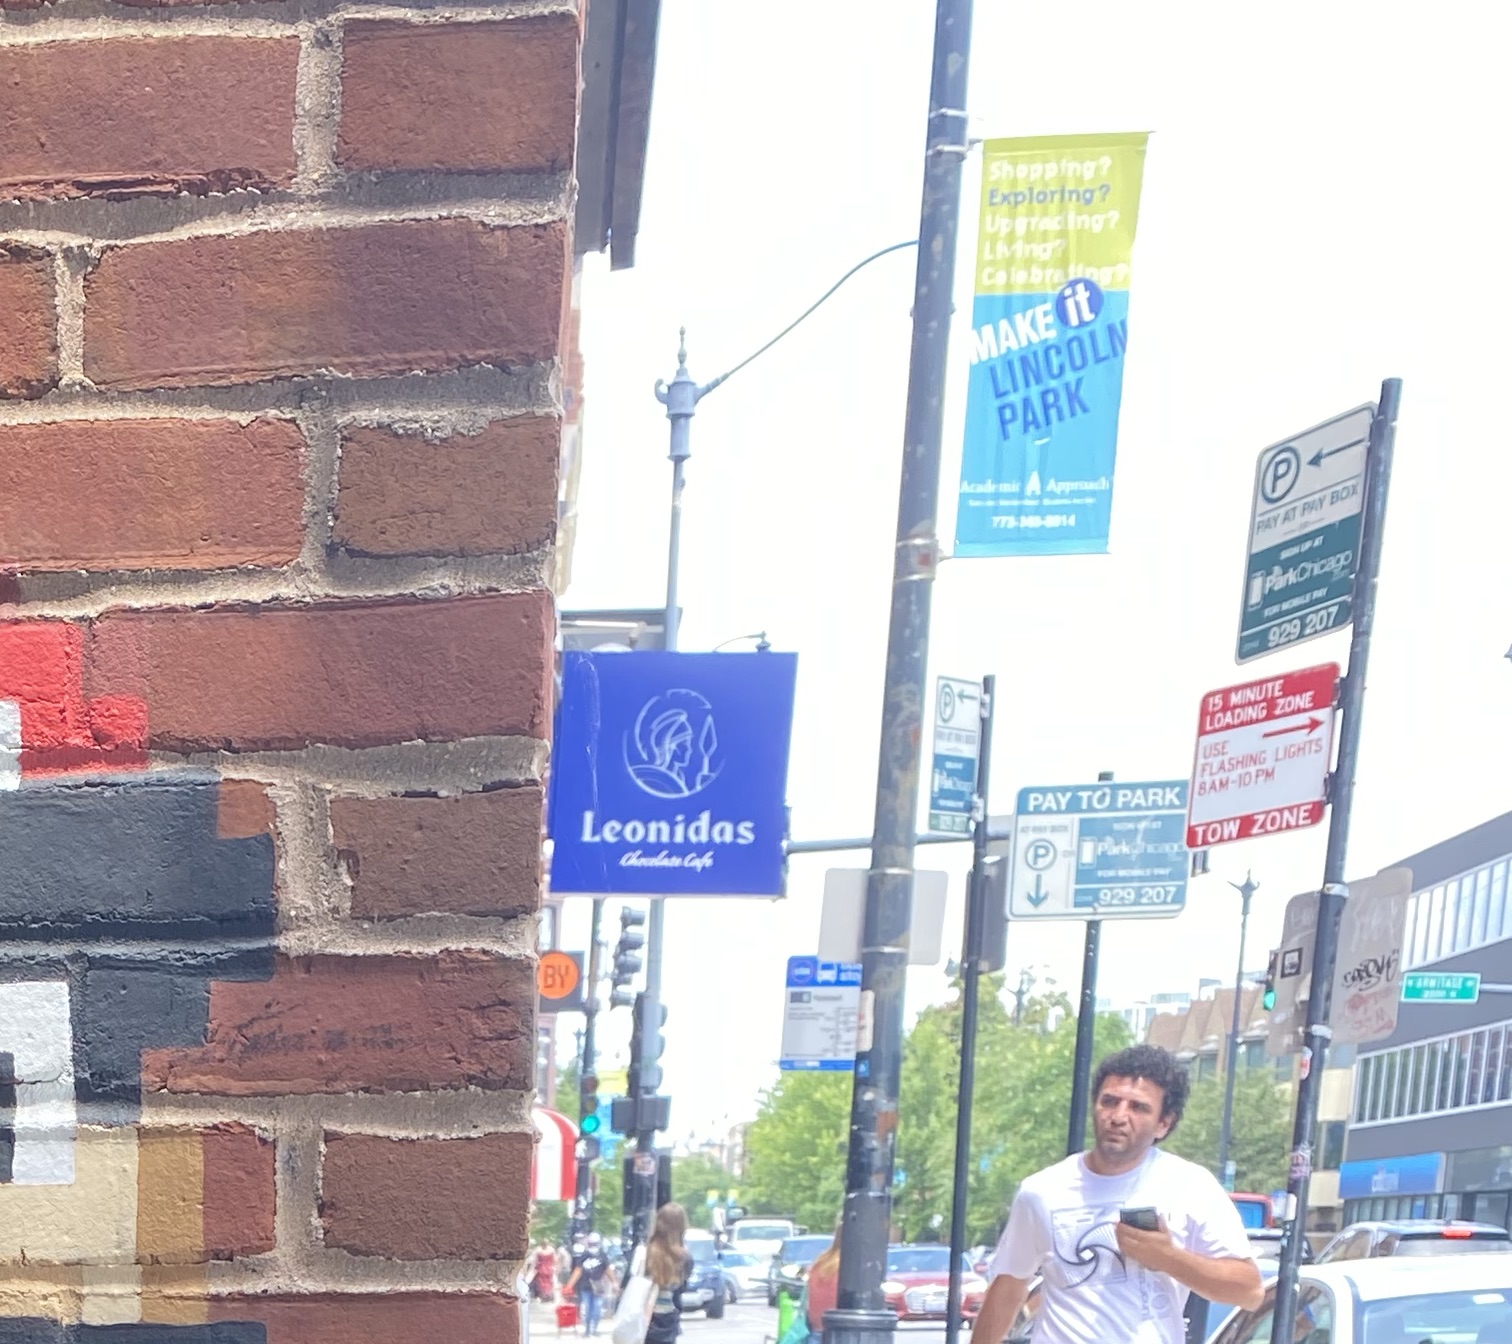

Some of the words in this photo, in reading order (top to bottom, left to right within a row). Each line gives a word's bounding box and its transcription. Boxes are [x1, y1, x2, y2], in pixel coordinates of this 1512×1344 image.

[989, 155, 1112, 182] Shopping?
[988, 183, 1111, 208] Exploring?
[983, 239, 1066, 261] Living?
[968, 302, 1056, 365] MAKE
[1063, 281, 1096, 328] it
[990, 319, 1128, 399] LINCOLN
[997, 376, 1090, 440] PARK
[1256, 516, 1279, 535] PAY
[1282, 508, 1297, 525] AT
[1302, 495, 1326, 517] PAY
[1330, 483, 1360, 507] BOX
[1264, 550, 1353, 594] ParkChicago
[1268, 619, 1301, 647] 929
[1304, 604, 1341, 634] 207
[1205, 699, 1268, 730] LOADING
[1274, 690, 1314, 715] ZONE
[1207, 691, 1224, 711] 15
[1229, 678, 1285, 707] MINUTE
[1200, 750, 1267, 779] FLASHING
[1274, 738, 1323, 763] LIGHTS
[1202, 740, 1230, 760] USE
[1028, 791, 1072, 812] PAY
[1077, 787, 1112, 809] TO
[1116, 786, 1182, 808] PARK
[581, 810, 756, 845] Leonidas
[1194, 821, 1240, 847] TOW
[1251, 802, 1313, 829] ZONE
[1099, 888, 1136, 905] 929
[1140, 887, 1177, 903] 207
[544, 964, 570, 989] BY
